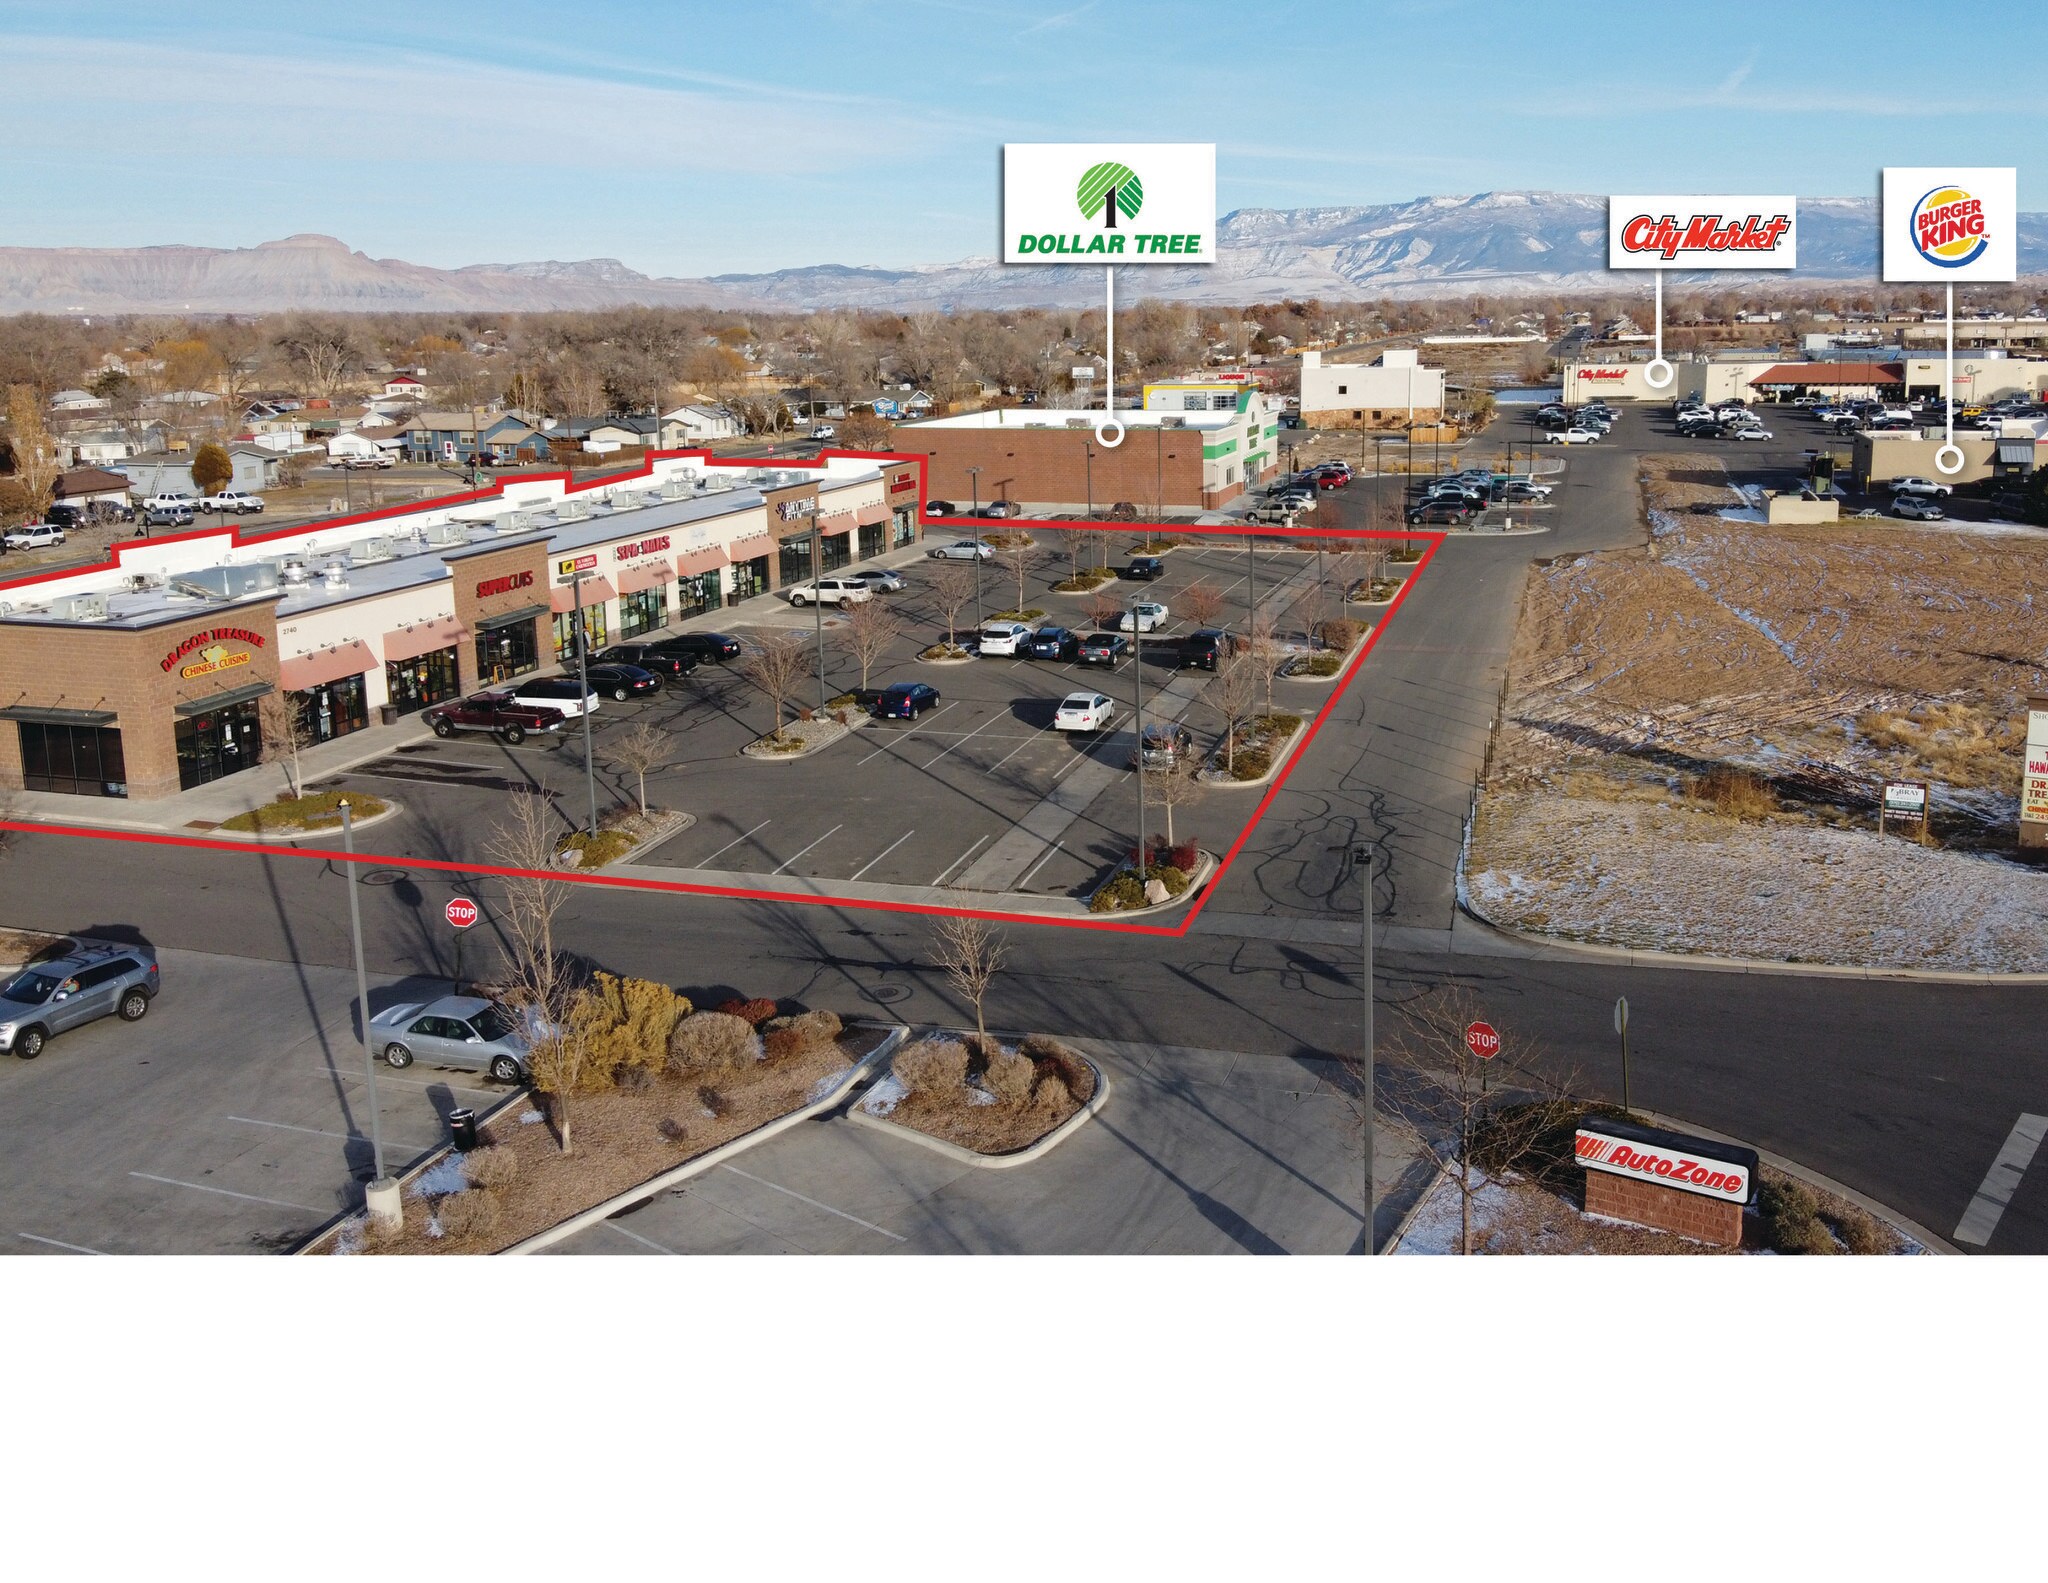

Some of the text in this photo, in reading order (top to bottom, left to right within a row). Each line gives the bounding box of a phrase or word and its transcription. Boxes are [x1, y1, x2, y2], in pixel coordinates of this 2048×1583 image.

[617, 543, 639, 561] SPA
[476, 571, 533, 599] SUPERCUTS
[283, 627, 297, 635] 2740
[160, 628, 265, 672] DRAGON TREASURE
[184, 653, 249, 677] CHINESE CUISINE
[2029, 761, 2048, 774] HAW
[2031, 780, 2048, 789] DR
[2028, 789, 2048, 798] TRE
[448, 906, 475, 919] STOP
[1468, 1031, 1497, 1048] STOP
[1607, 1145, 1743, 1194] AutoZone
